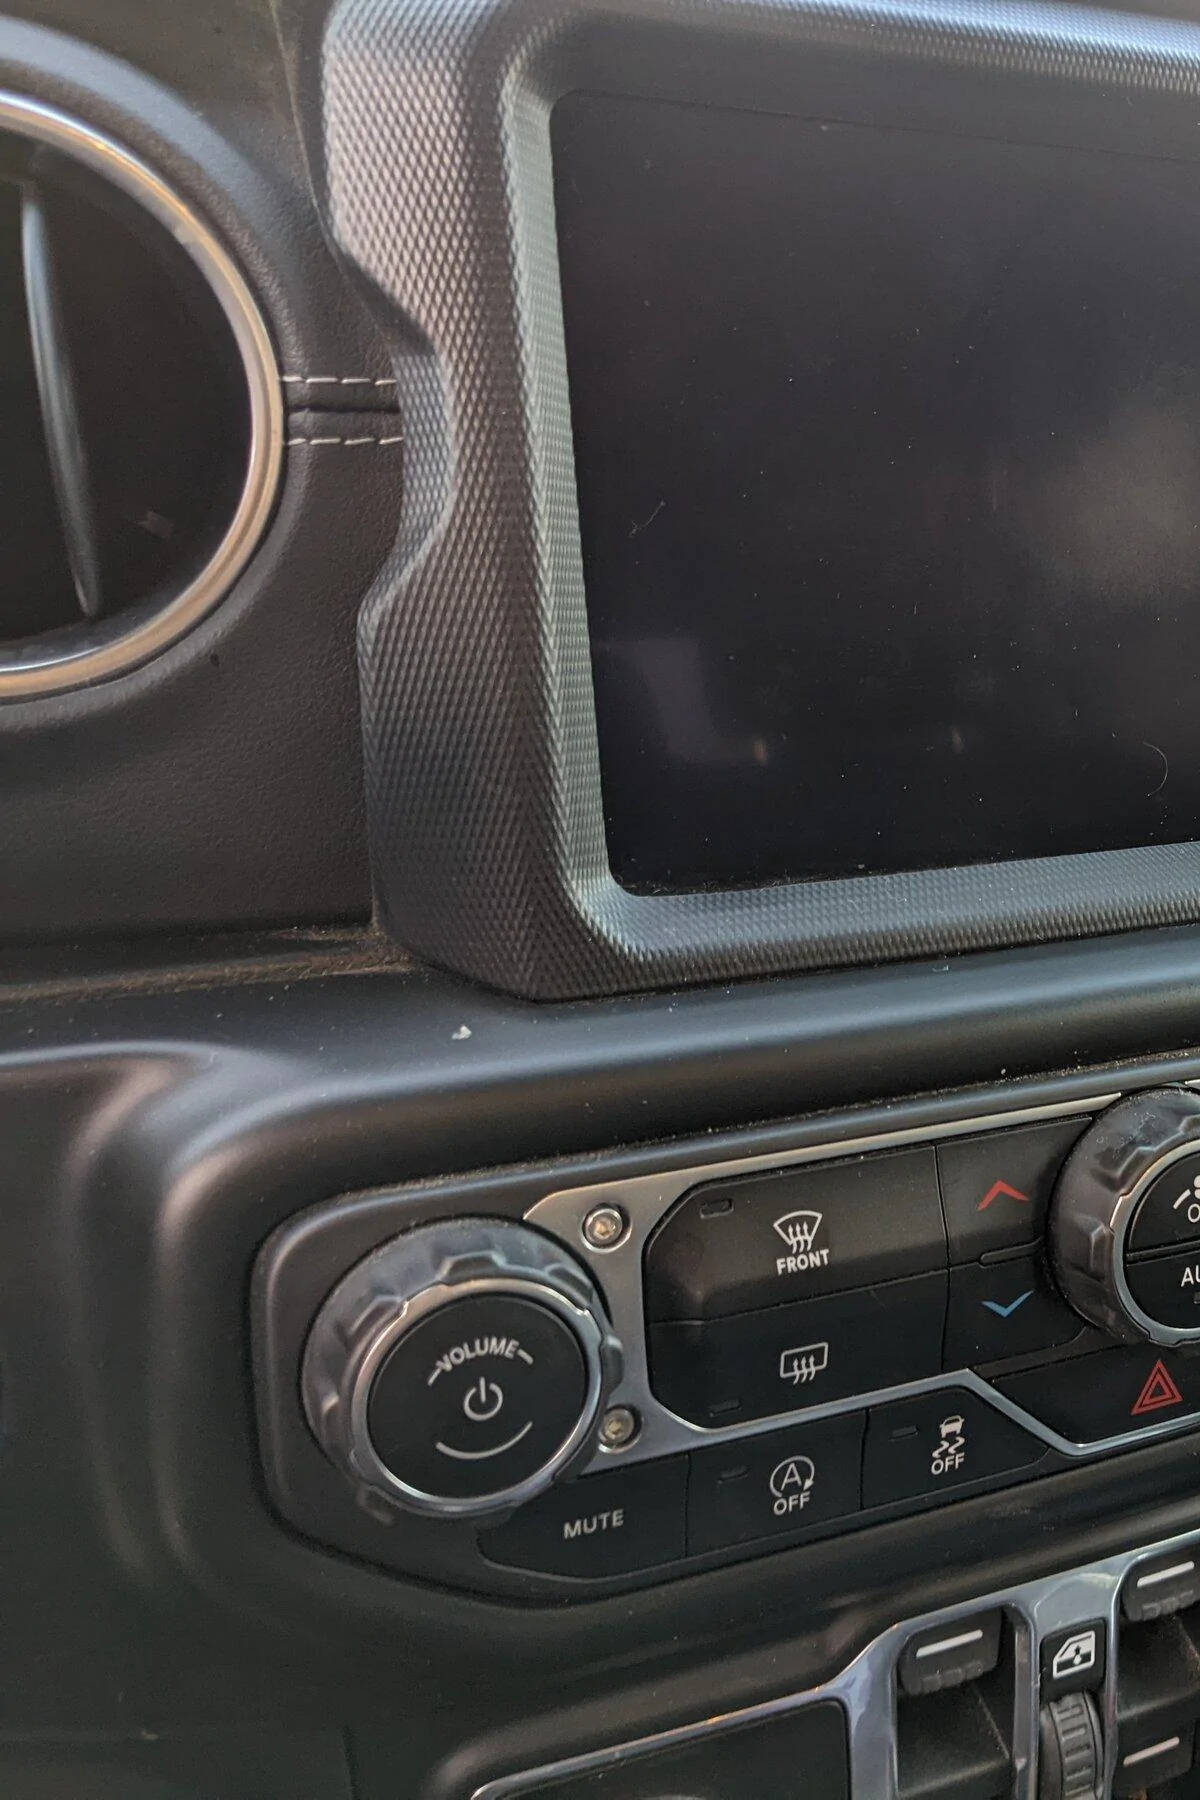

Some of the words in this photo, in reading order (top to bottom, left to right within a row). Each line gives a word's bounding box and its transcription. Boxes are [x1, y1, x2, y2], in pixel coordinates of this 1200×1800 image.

[775, 1248, 830, 1276] FRONT
[435, 1335, 520, 1372] VOLUME
[930, 1452, 965, 1476] OFF
[773, 1491, 811, 1516] OFF
[563, 1508, 625, 1540] MUTE
